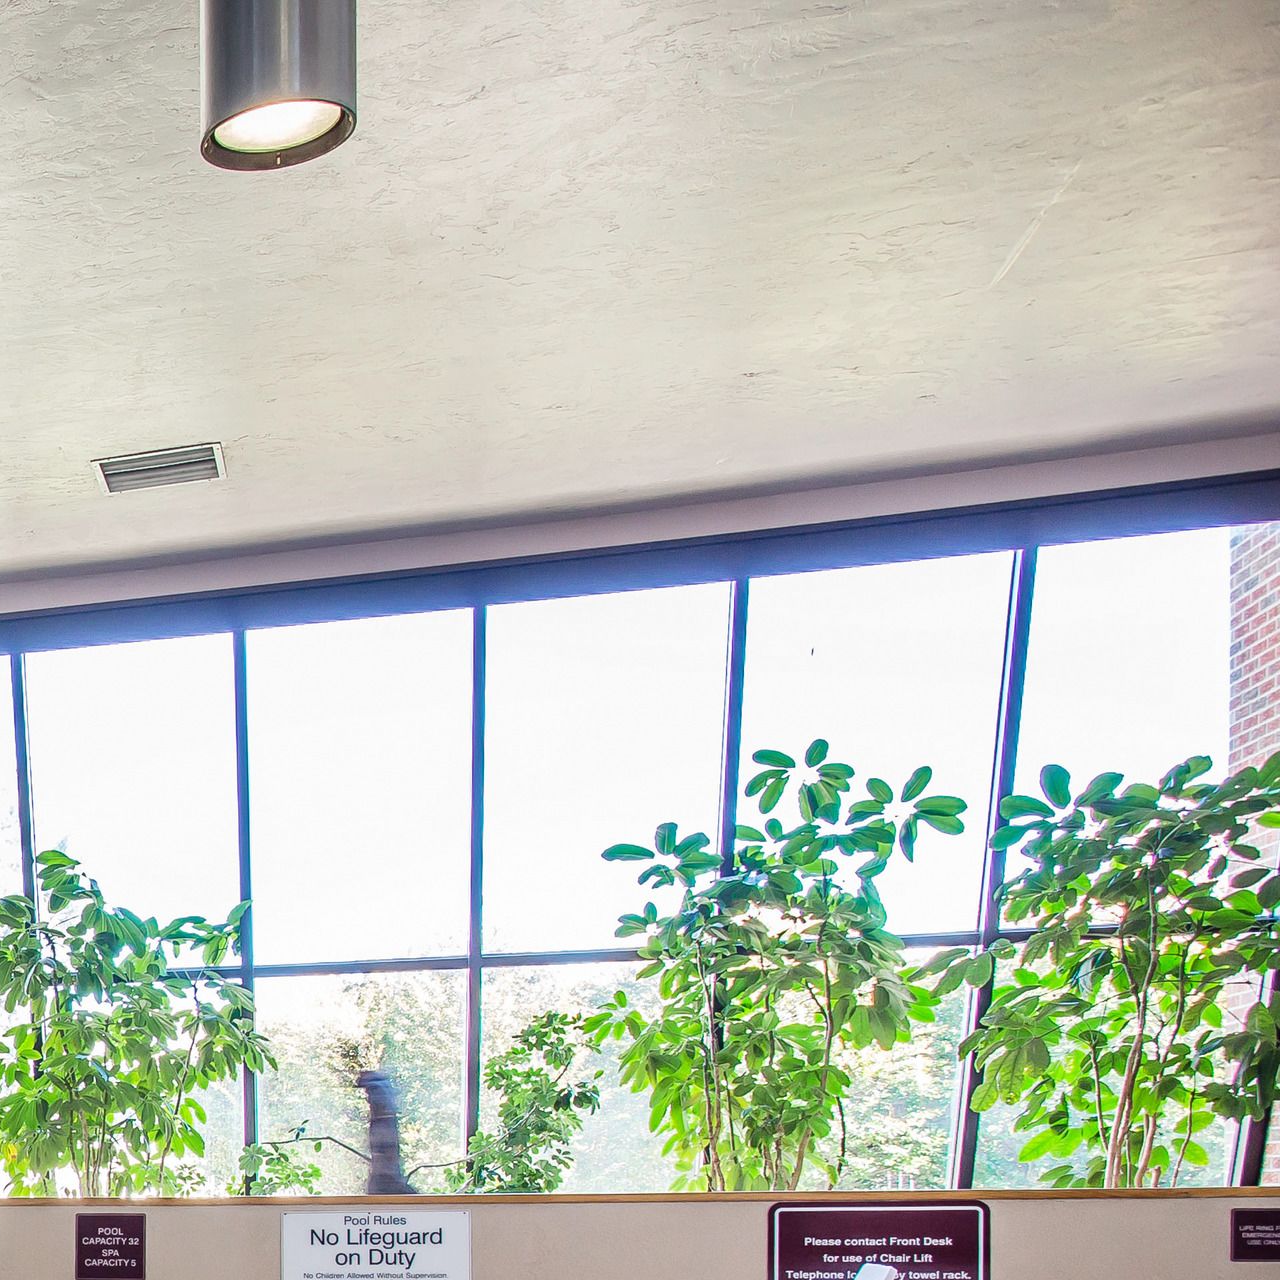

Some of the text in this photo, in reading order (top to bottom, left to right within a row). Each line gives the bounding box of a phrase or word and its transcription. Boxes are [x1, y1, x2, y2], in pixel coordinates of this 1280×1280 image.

[344, 1216, 407, 1225] Pool Rules
[97, 1227, 124, 1236] POOL
[82, 1237, 140, 1245] CAPACITY 32
[310, 1228, 442, 1249] No Lifeguard
[804, 1237, 953, 1246] Please contact Front Desk
[101, 1249, 120, 1257] SPA
[84, 1258, 137, 1267] CAPACITY 5
[335, 1249, 416, 1269] on Duty
[823, 1254, 933, 1263] for use of Chair Lift
[785, 1271, 844, 1280] Telephone
[909, 1271, 940, 1279] towel
[942, 1271, 971, 1279] rack.
